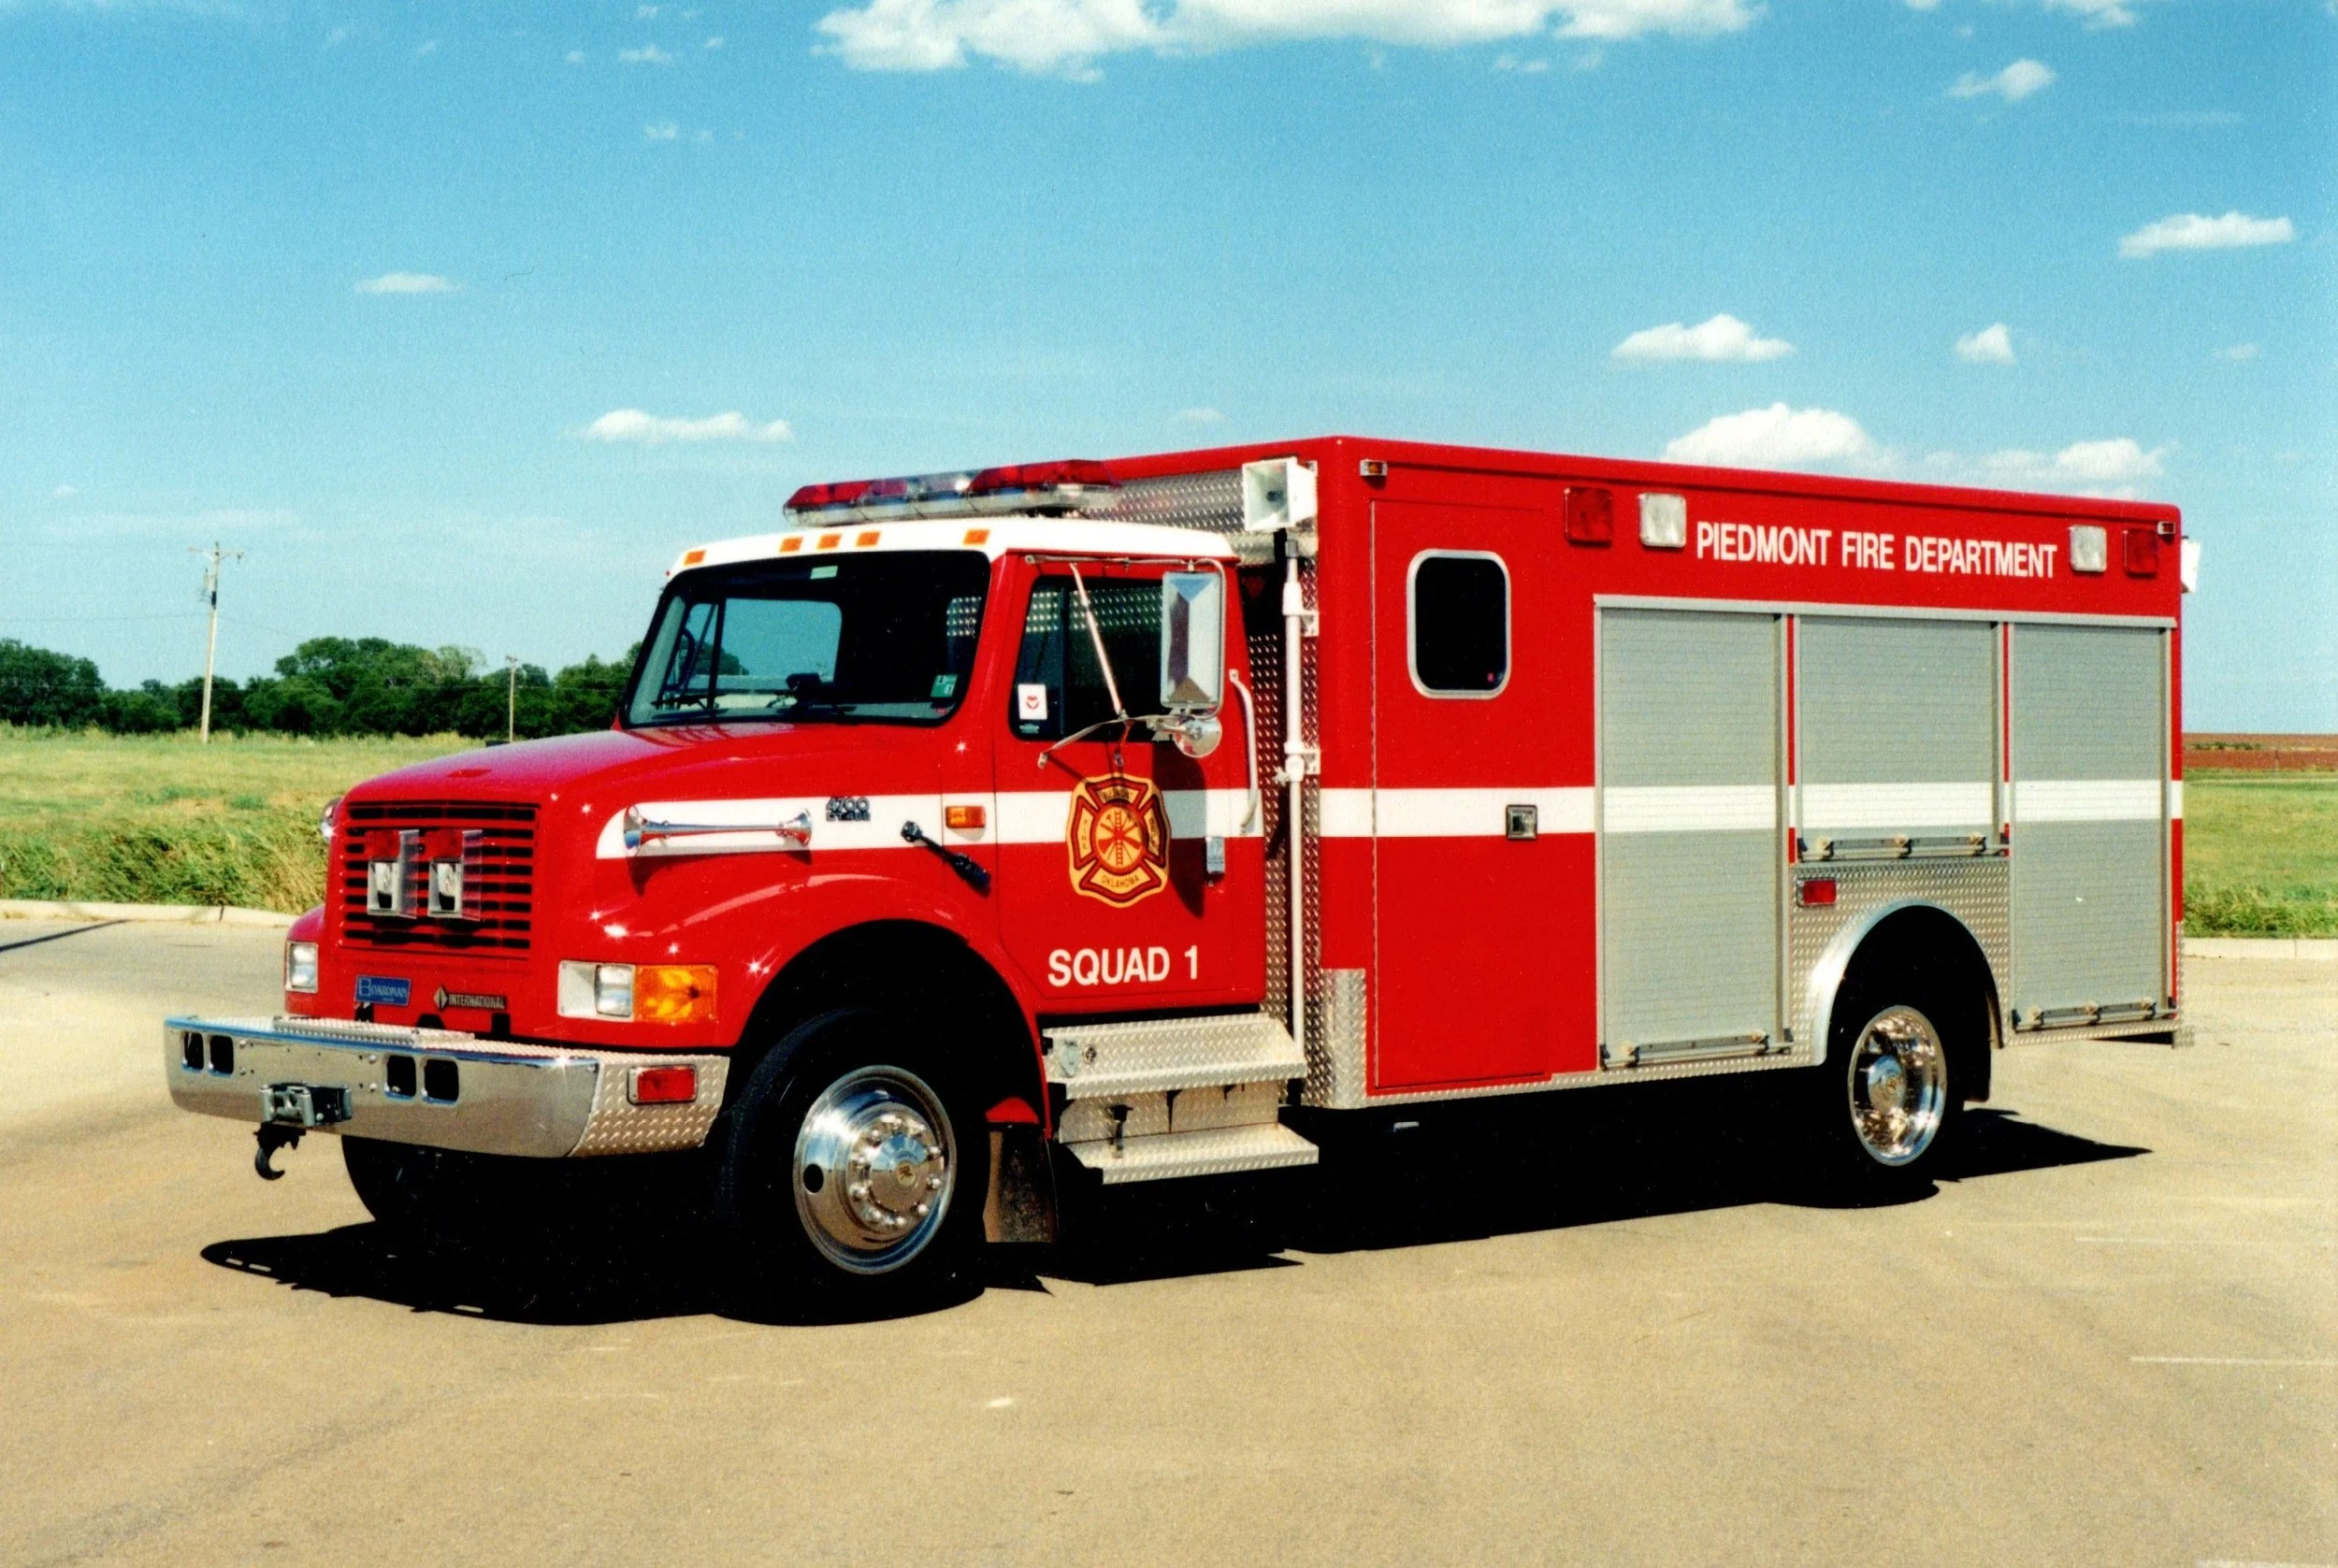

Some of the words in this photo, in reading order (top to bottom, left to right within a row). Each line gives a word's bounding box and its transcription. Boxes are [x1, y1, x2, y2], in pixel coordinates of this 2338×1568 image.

[1696, 521, 1832, 566] PIEDMONT
[1841, 530, 1895, 570] FIRE
[1904, 535, 2057, 579] DEPARTMENT
[1101, 873, 1140, 888] OKLAHOMA
[1047, 946, 1171, 987] SQUAD
[1184, 944, 1198, 980] 1
[448, 993, 506, 1010] INTERNATIONAL
